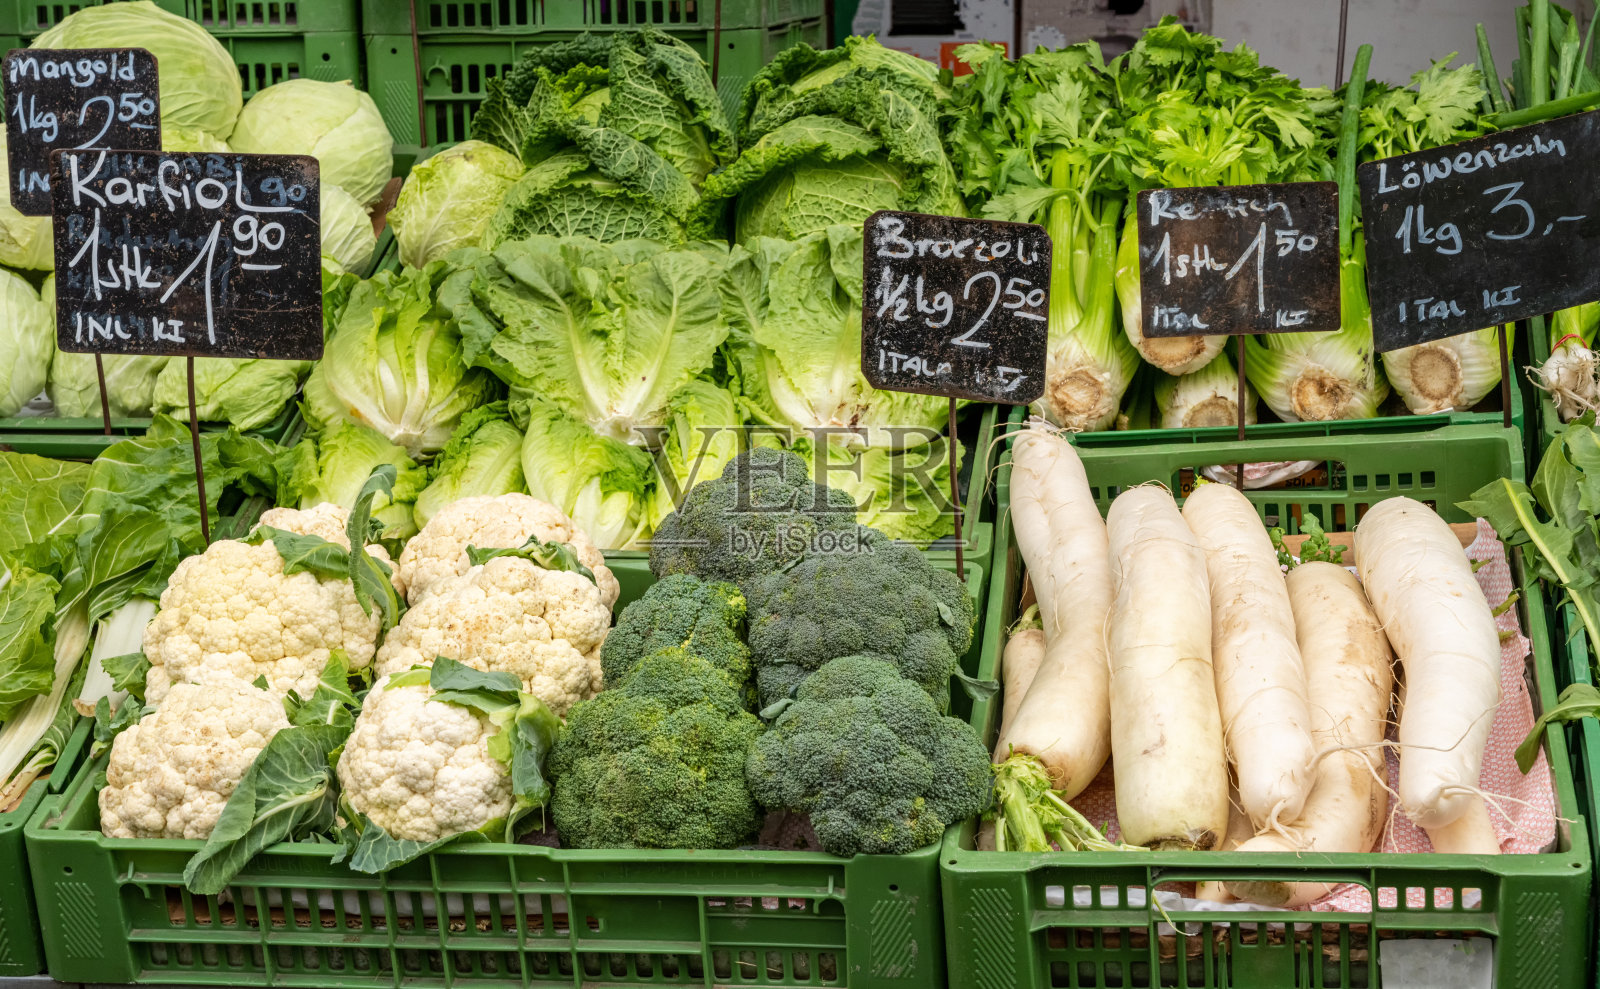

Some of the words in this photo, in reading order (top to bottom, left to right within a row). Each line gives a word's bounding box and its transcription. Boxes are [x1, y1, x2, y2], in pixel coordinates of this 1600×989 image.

[10, 51, 136, 88] Mangold
[1378, 134, 1567, 194] Löwenzahn
[1149, 189, 1293, 227] Retich
[877, 218, 1038, 265] Broccoli
